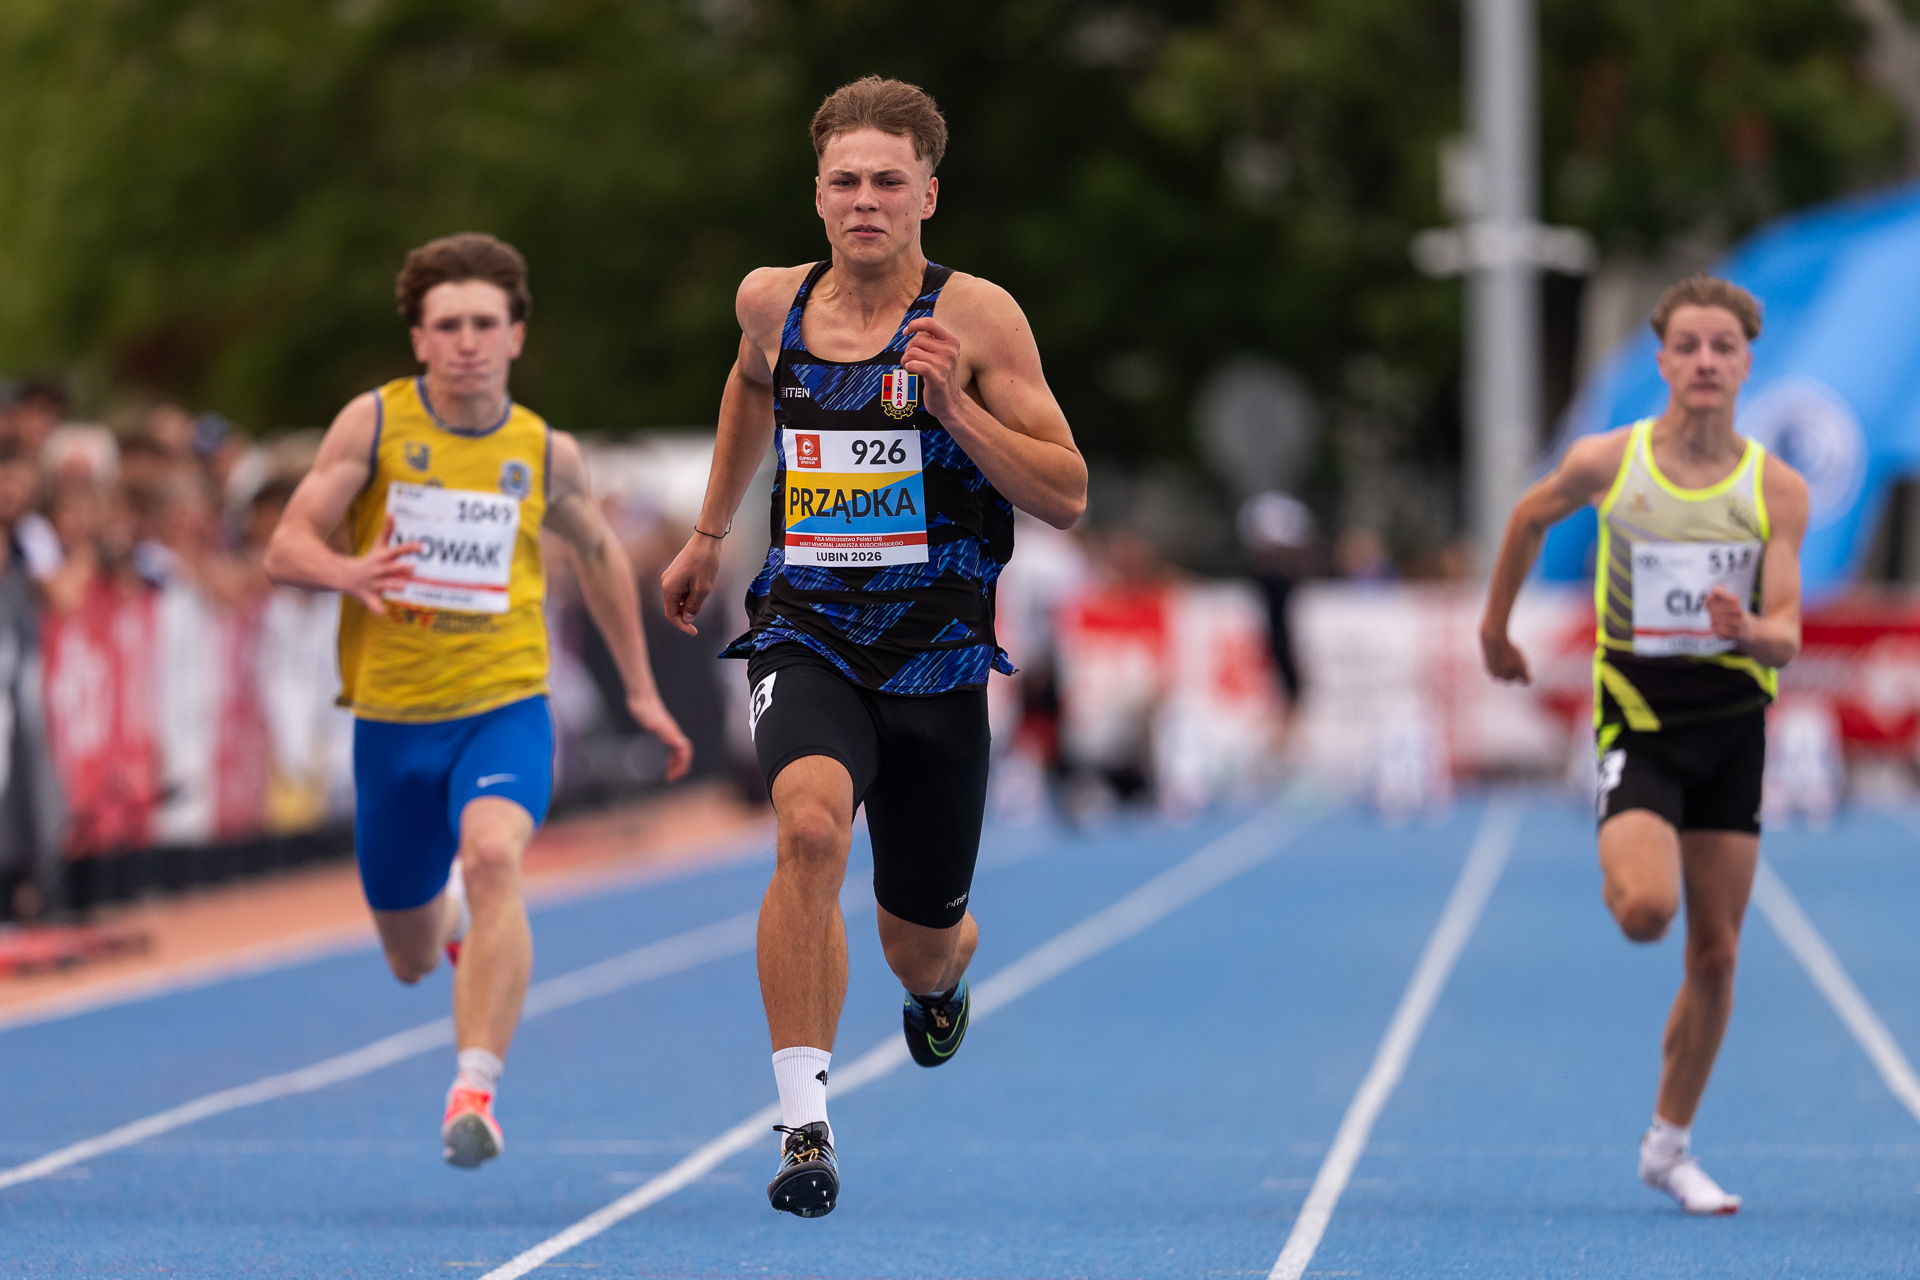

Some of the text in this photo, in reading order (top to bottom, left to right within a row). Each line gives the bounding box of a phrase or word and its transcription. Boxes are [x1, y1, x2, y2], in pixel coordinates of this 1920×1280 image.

[896, 371, 904, 407] ISKRA
[851, 438, 907, 465] 926
[789, 486, 918, 525] PRZĄDKA
[816, 551, 882, 562] LUBIN 2026
[860, 540, 904, 548] KUSOCIŃSKIEGO
